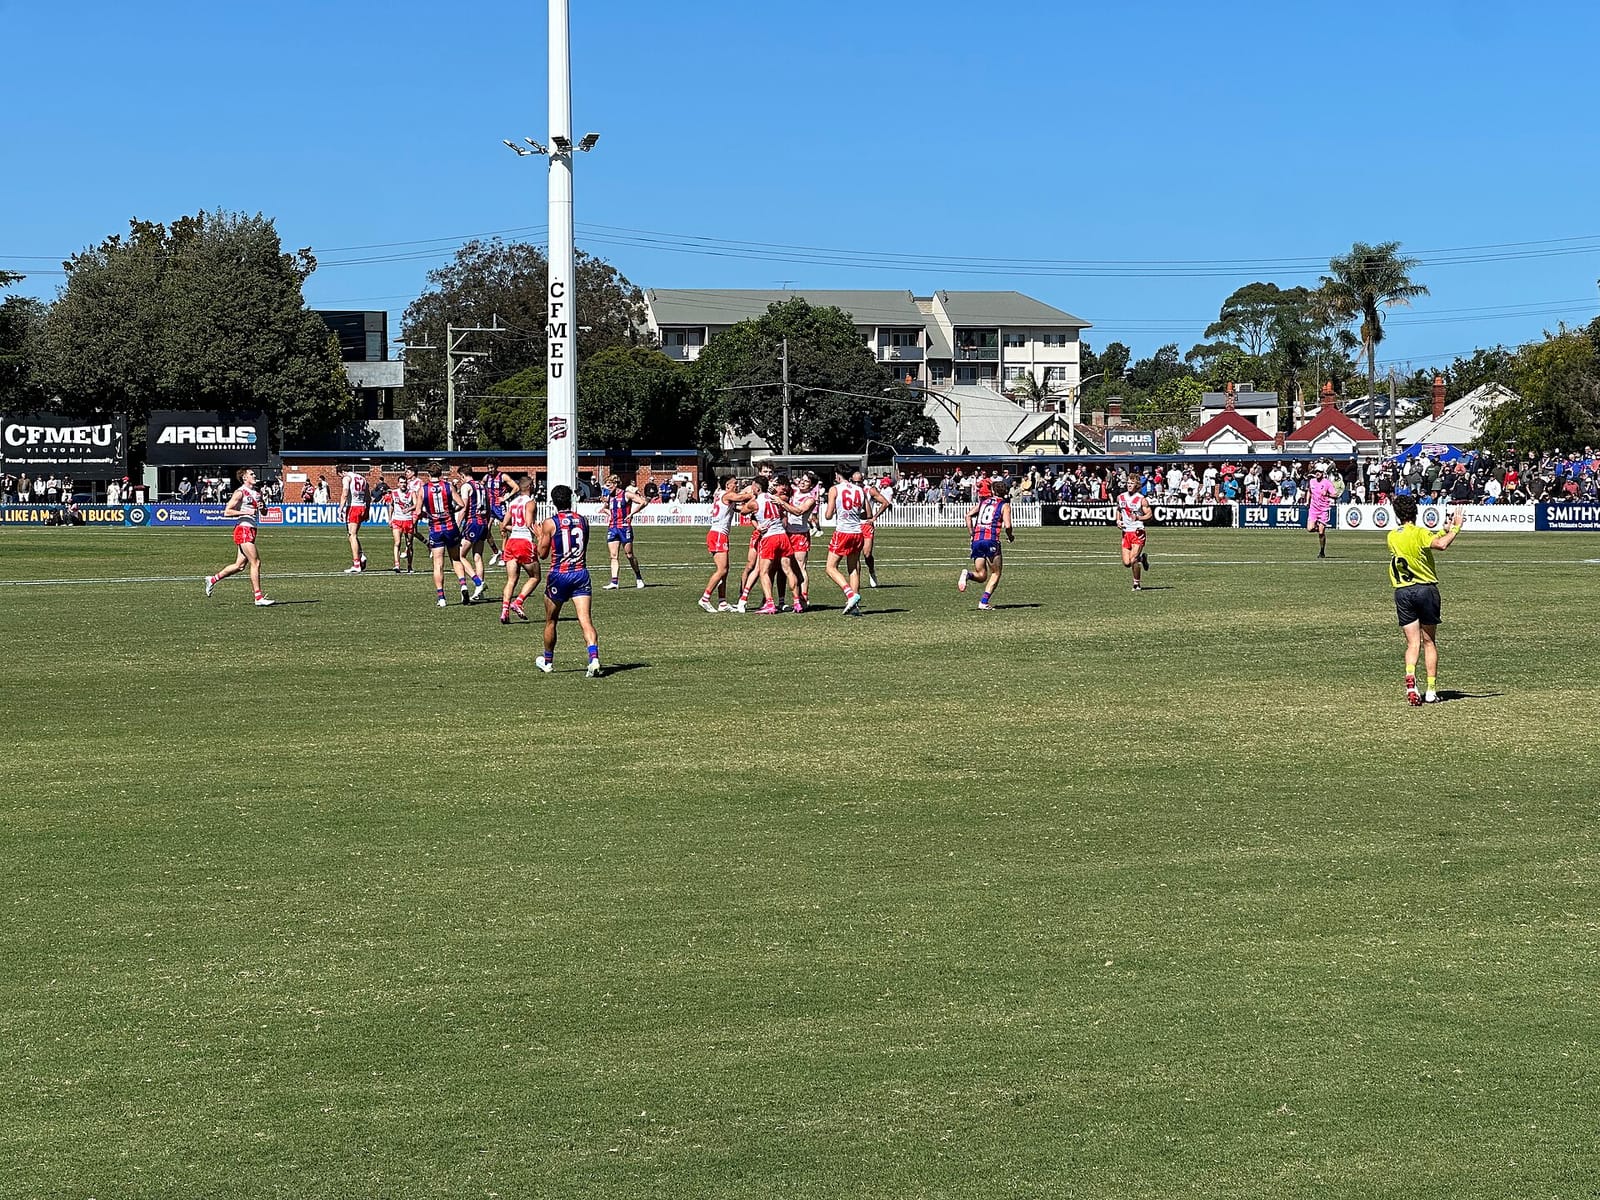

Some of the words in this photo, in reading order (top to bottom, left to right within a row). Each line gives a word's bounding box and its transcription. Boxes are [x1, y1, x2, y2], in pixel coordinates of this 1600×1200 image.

[549, 282, 567, 378] CFMEU
[4, 424, 113, 446] CFMEU
[156, 426, 257, 444] ARGUS
[842, 490, 862, 510] 64
[5, 510, 29, 521] LIKE
[30, 510, 38, 521] A
[88, 510, 124, 521] BUCKS
[170, 509, 188, 517] Simply
[285, 506, 347, 523] CHEMIS
[511, 504, 526, 527] 59
[978, 503, 995, 524] 18
[1058, 506, 1117, 521] CFMEU
[1154, 506, 1214, 521] CFMEU
[1462, 514, 1534, 523] STANNARDS
[561, 527, 584, 557] 13
[1391, 556, 1414, 584] 13
